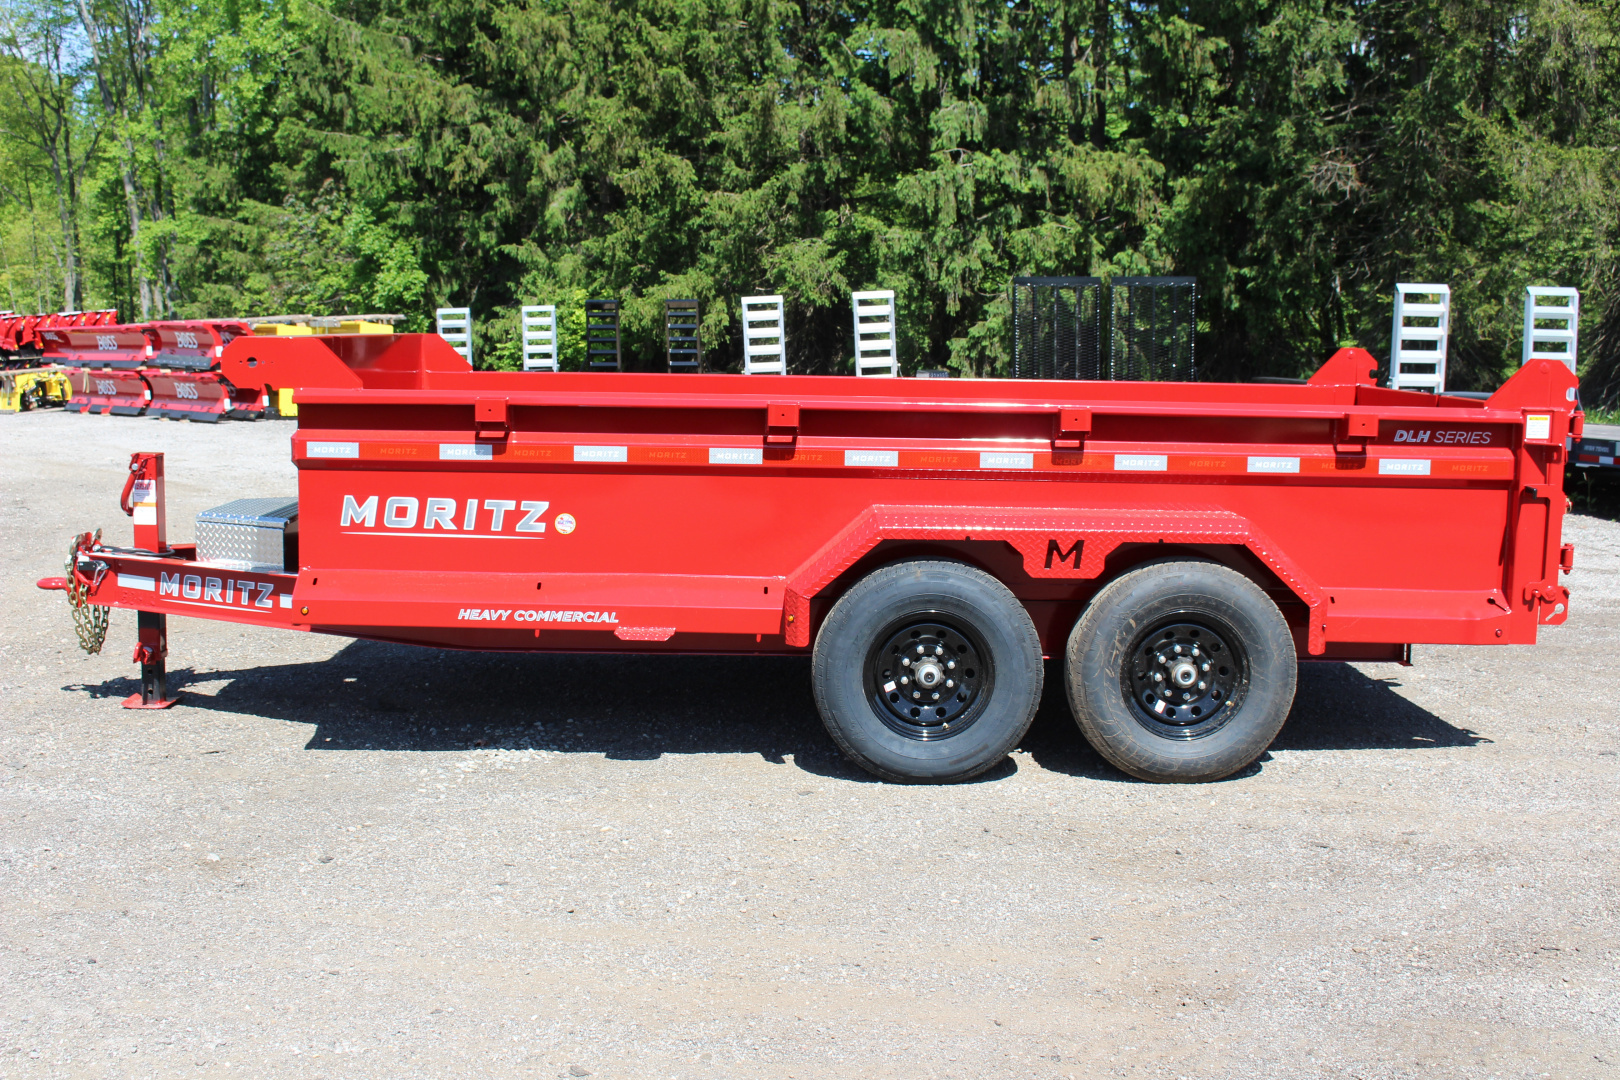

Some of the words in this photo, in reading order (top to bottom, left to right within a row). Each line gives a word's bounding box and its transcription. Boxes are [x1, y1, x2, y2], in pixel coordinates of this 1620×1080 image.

[96, 335, 118, 351] BOSS
[174, 331, 198, 349] BOSS
[96, 380, 117, 395] BOSS
[173, 382, 198, 399] BOSS
[1394, 429, 1431, 443] DLH
[1433, 430, 1492, 445] SERIES
[313, 446, 351, 454] MORITZ
[447, 448, 484, 456] MORITZ
[716, 452, 754, 460] MORITZ
[1055, 458, 1092, 466] MORITZ
[1122, 459, 1160, 467] MORITZ
[1189, 460, 1227, 468] MORITZ
[1254, 461, 1293, 469] MORITZ
[1386, 463, 1423, 471] MORITZ
[340, 495, 550, 533] MORITZ
[1043, 539, 1085, 570] M
[159, 571, 275, 608] MORITZ
[458, 608, 512, 621] HEAVY
[514, 609, 619, 624] COMMERCIAL
